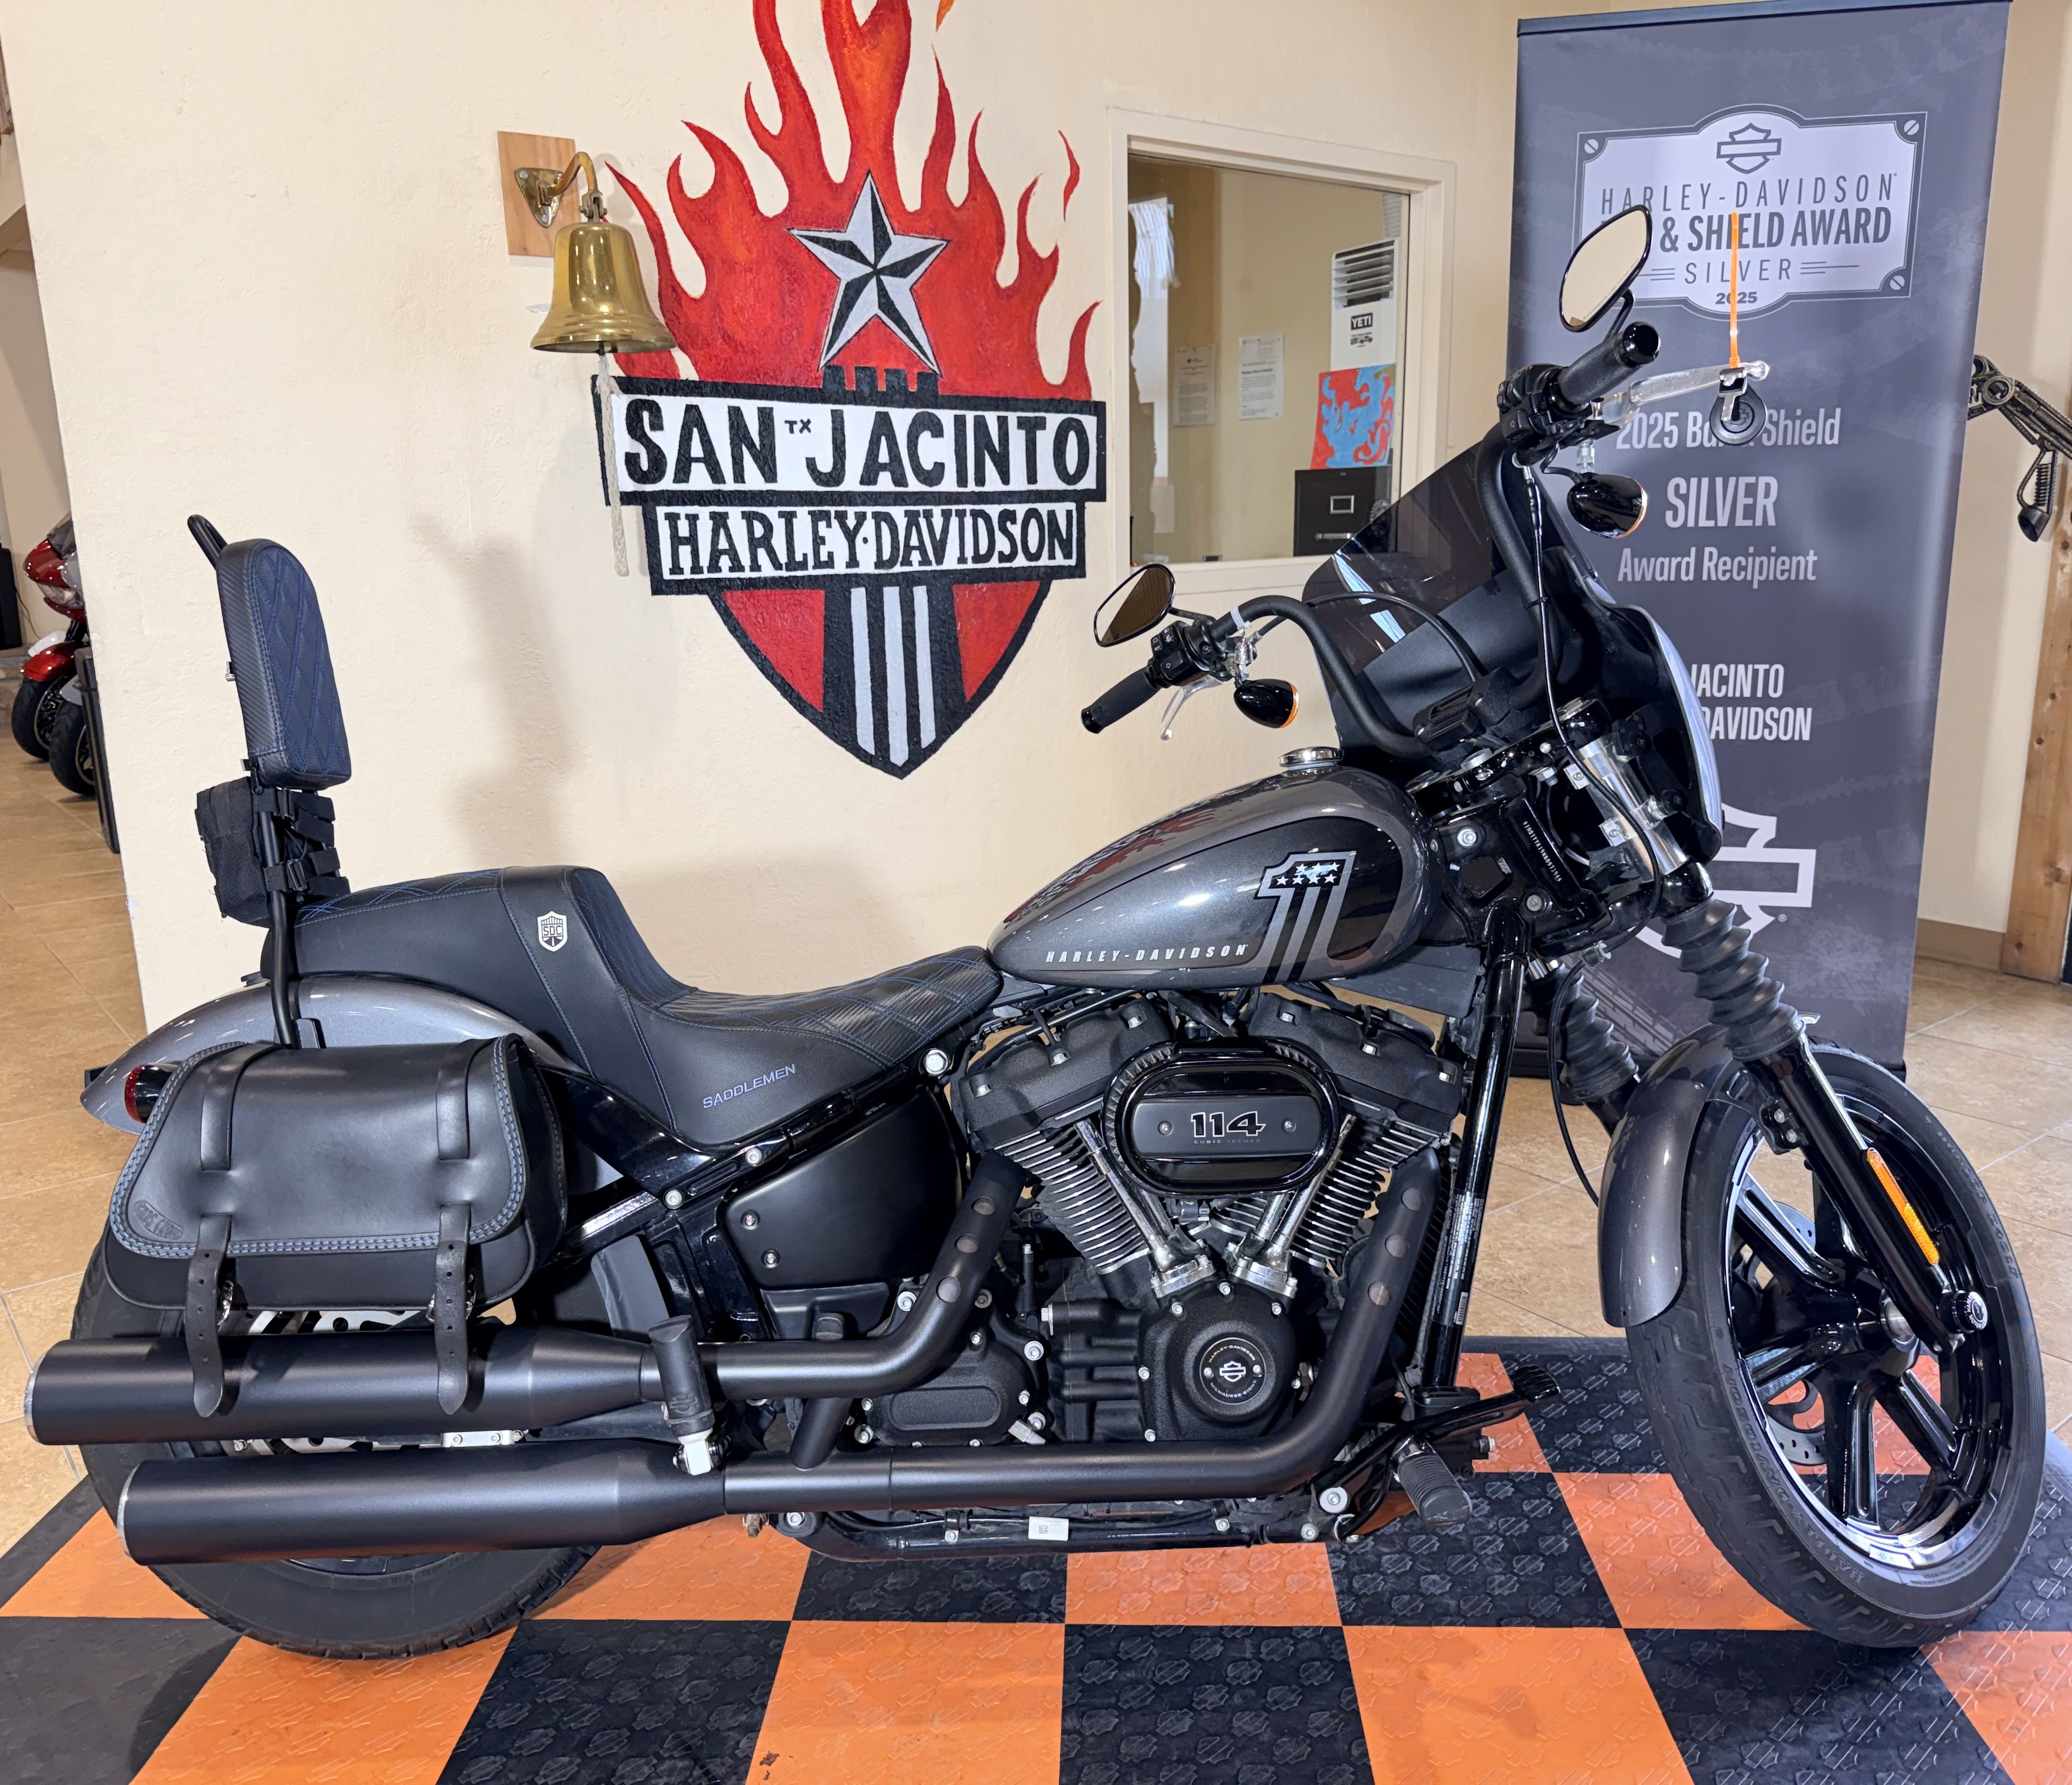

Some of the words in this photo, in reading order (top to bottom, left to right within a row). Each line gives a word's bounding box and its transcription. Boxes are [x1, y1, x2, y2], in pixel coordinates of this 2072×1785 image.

[1659, 216, 1679, 253] &
[1688, 212, 1785, 251] SHIELD
[1790, 207, 1891, 247] AWARD
[1684, 259, 1792, 284] SILVER
[1351, 315, 1372, 328] YETI
[624, 398, 777, 485] SAN
[784, 417, 812, 434] TX
[805, 408, 1090, 488] JACINTO
[1686, 411, 1724, 448] Ba
[1762, 407, 1841, 446] Shield
[1665, 475, 1779, 528] SILVER
[1617, 546, 1696, 582] Award
[1701, 545, 1818, 589] Recipient
[543, 925, 562, 936] SDC
[1045, 944, 1247, 963] HARLEY-DAVIDSON
[702, 1064, 796, 1109] SADDLEMEN
[1190, 1110, 1267, 1138] 114
[1208, 1345, 1256, 1363] HARLEY-DAVIDSON
